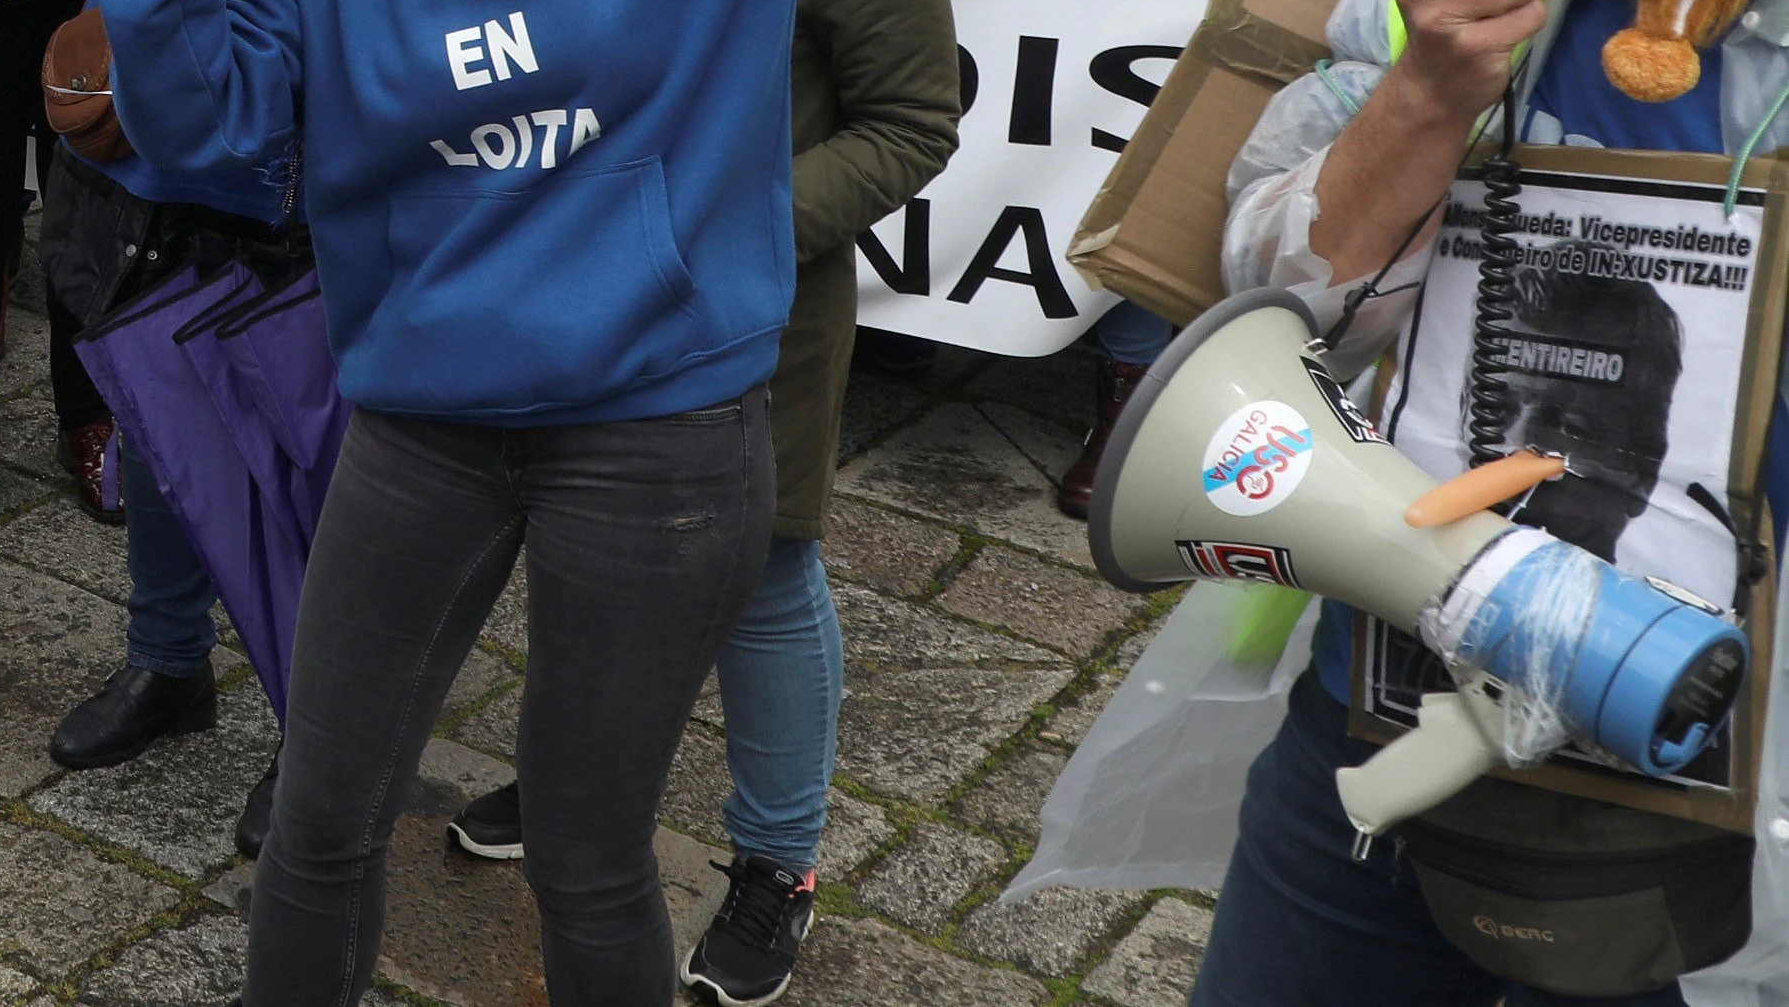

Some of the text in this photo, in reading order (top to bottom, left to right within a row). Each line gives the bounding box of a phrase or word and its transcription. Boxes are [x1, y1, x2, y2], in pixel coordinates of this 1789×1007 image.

[445, 11, 539, 90] EN
[429, 108, 601, 170] LOITA
[1440, 241, 1450, 256] e
[1557, 246, 1584, 270] de
[1580, 217, 1752, 257] Vicepresidente
[1493, 336, 1625, 382] ENTIREIRO
[1208, 408, 1268, 483] GALICIA
